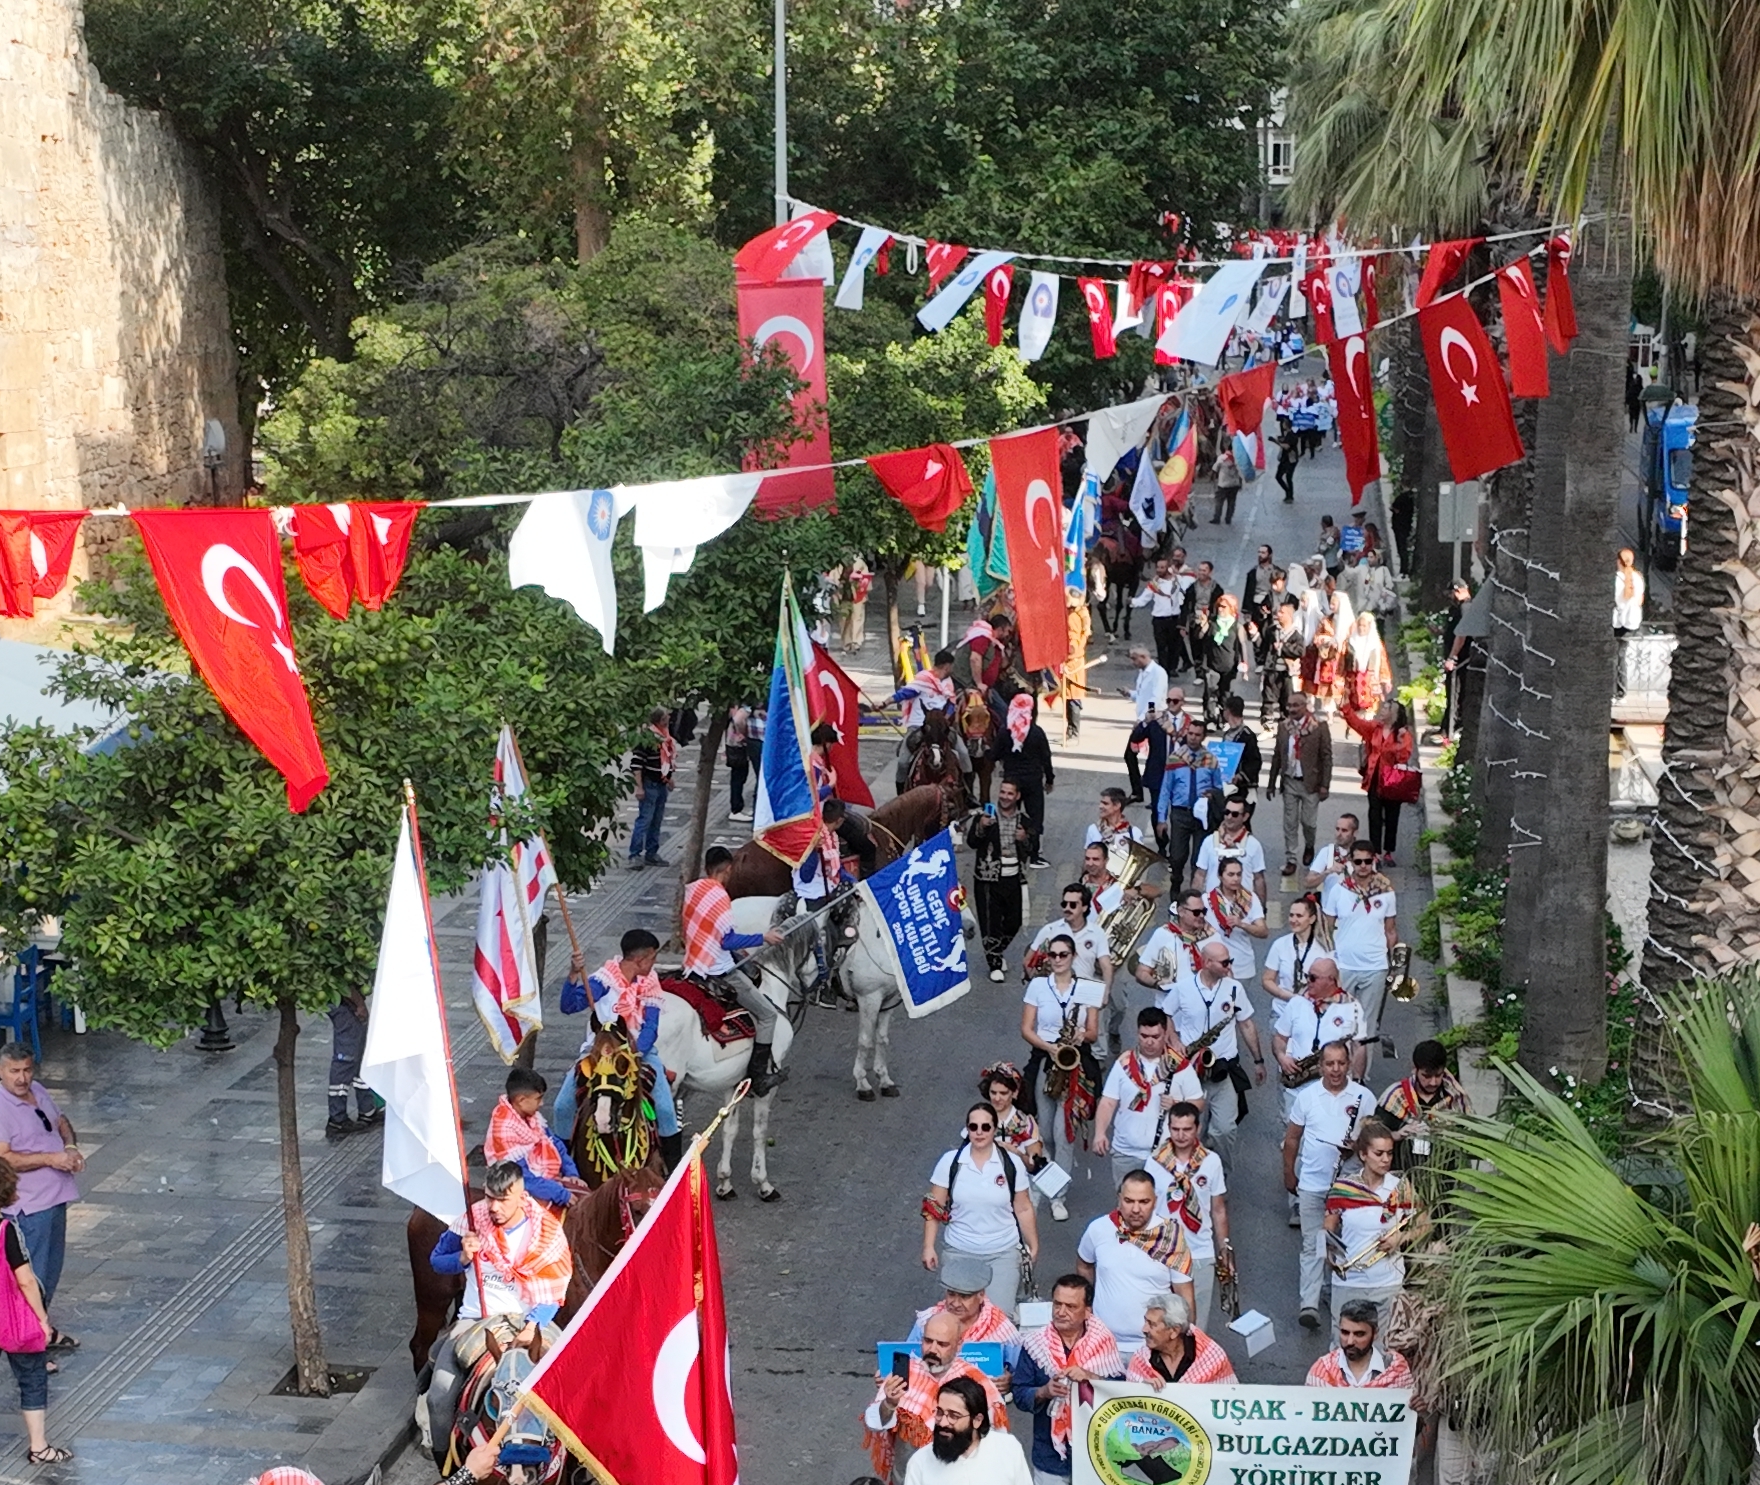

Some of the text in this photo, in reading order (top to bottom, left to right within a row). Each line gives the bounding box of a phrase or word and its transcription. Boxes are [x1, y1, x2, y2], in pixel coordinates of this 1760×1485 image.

[891, 883, 911, 920] SPOR
[926, 889, 950, 931] GENÇ
[906, 883, 941, 957] UMUT ATLI
[1210, 1399, 1286, 1426] UŞAK
[1311, 1401, 1406, 1422] BANAZ
[1131, 1425, 1166, 1436] BANAZ
[1216, 1431, 1399, 1457] BULGAZDAĞI
